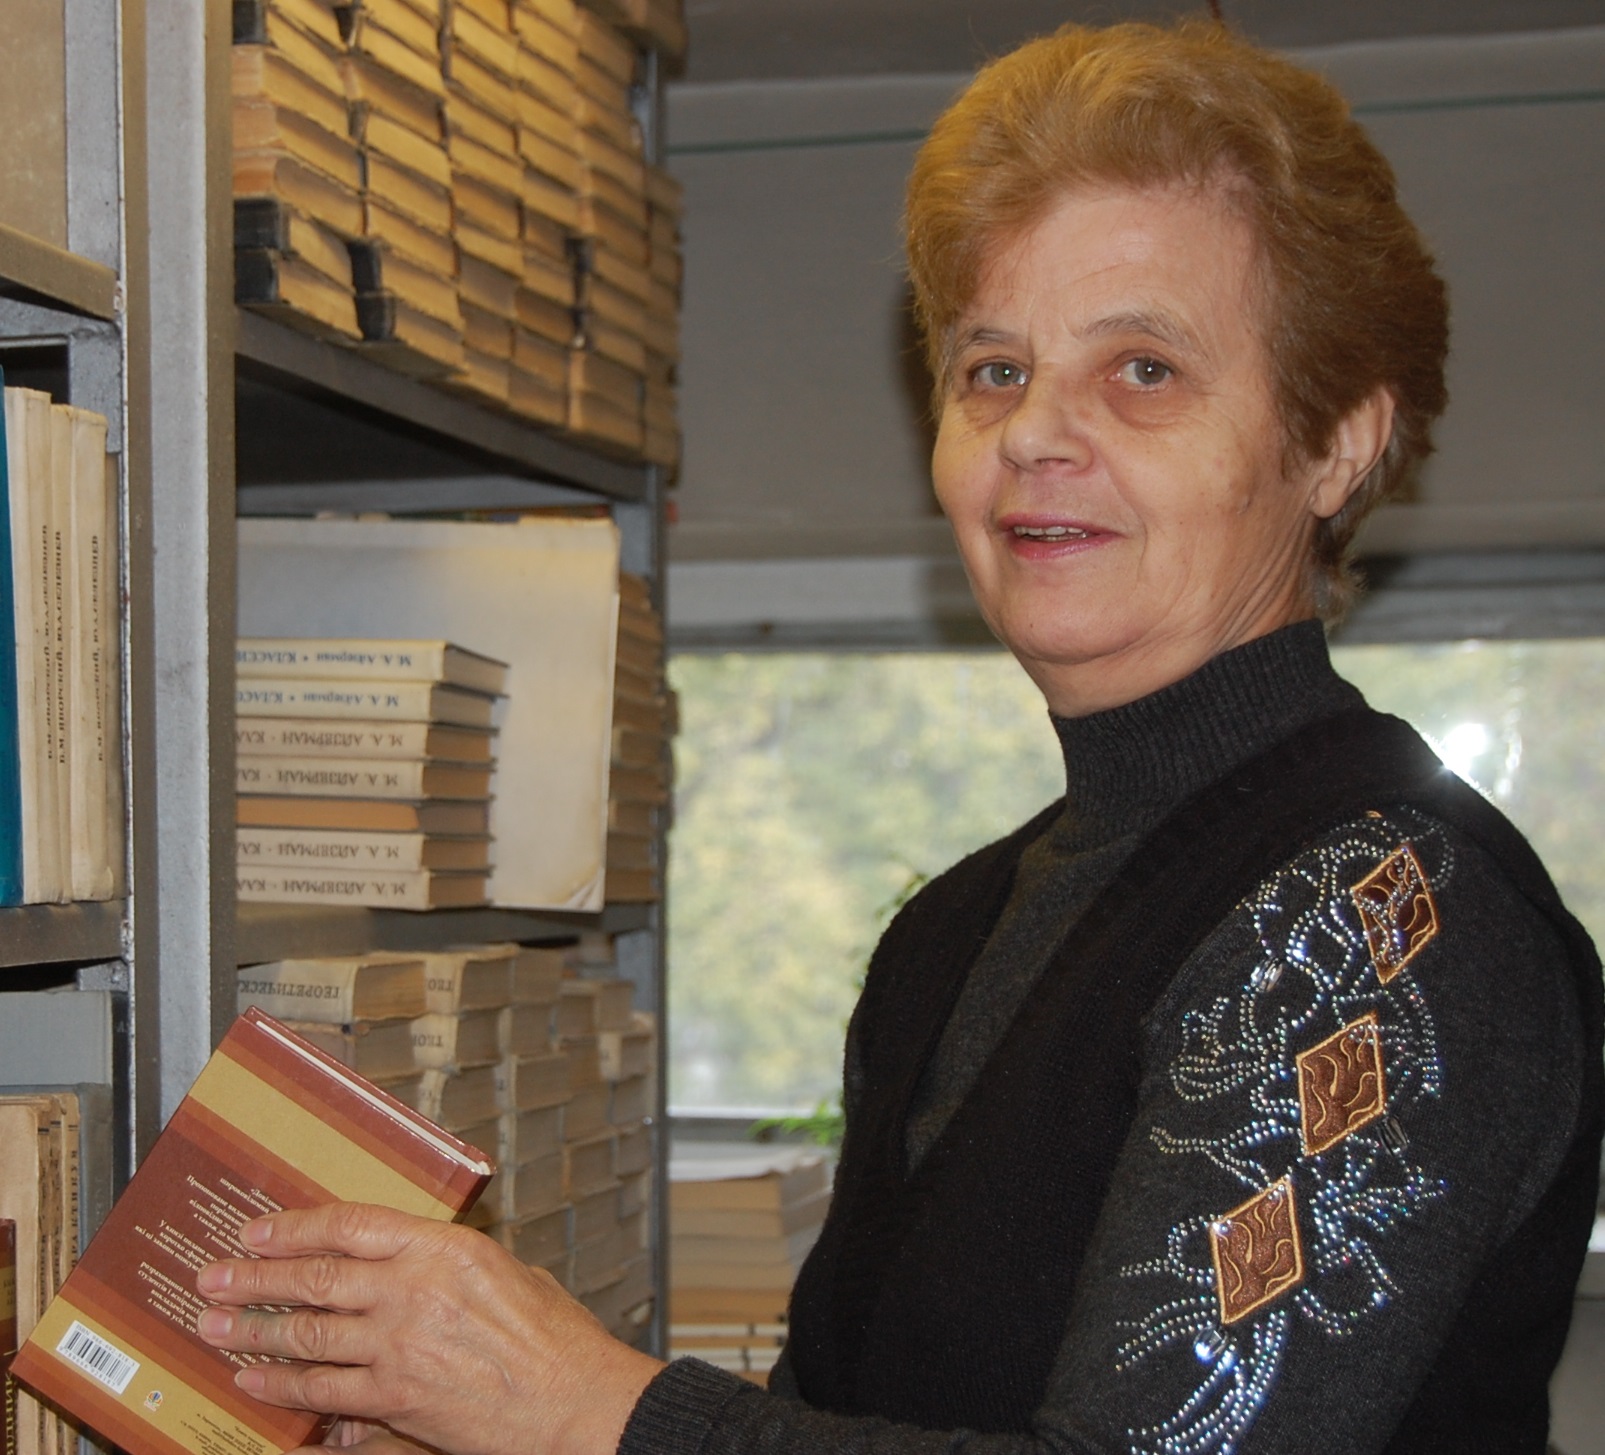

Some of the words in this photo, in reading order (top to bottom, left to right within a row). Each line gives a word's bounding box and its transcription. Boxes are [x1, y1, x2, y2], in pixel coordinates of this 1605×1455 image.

[236, 650, 296, 662] КЛАССИ
[236, 691, 282, 702] КЛАСС
[236, 730, 264, 742] КЛА
[283, 731, 362, 746] АЙЗЕРМАН
[388, 733, 402, 745] М.
[278, 770, 358, 785] АЙЗЕРМАН
[384, 774, 398, 785] М.
[278, 842, 358, 857] АЙЗЕРМАН
[384, 845, 398, 857] М.
[236, 879, 265, 890] КЛА
[284, 880, 364, 895] АЙЗЕРМАН
[390, 882, 404, 894] М.
[427, 979, 452, 991] ТЕО
[250, 1188, 282, 1213] «Довідник
[184, 1249, 208, 1268] сформу
[191, 1294, 207, 1308] інже
